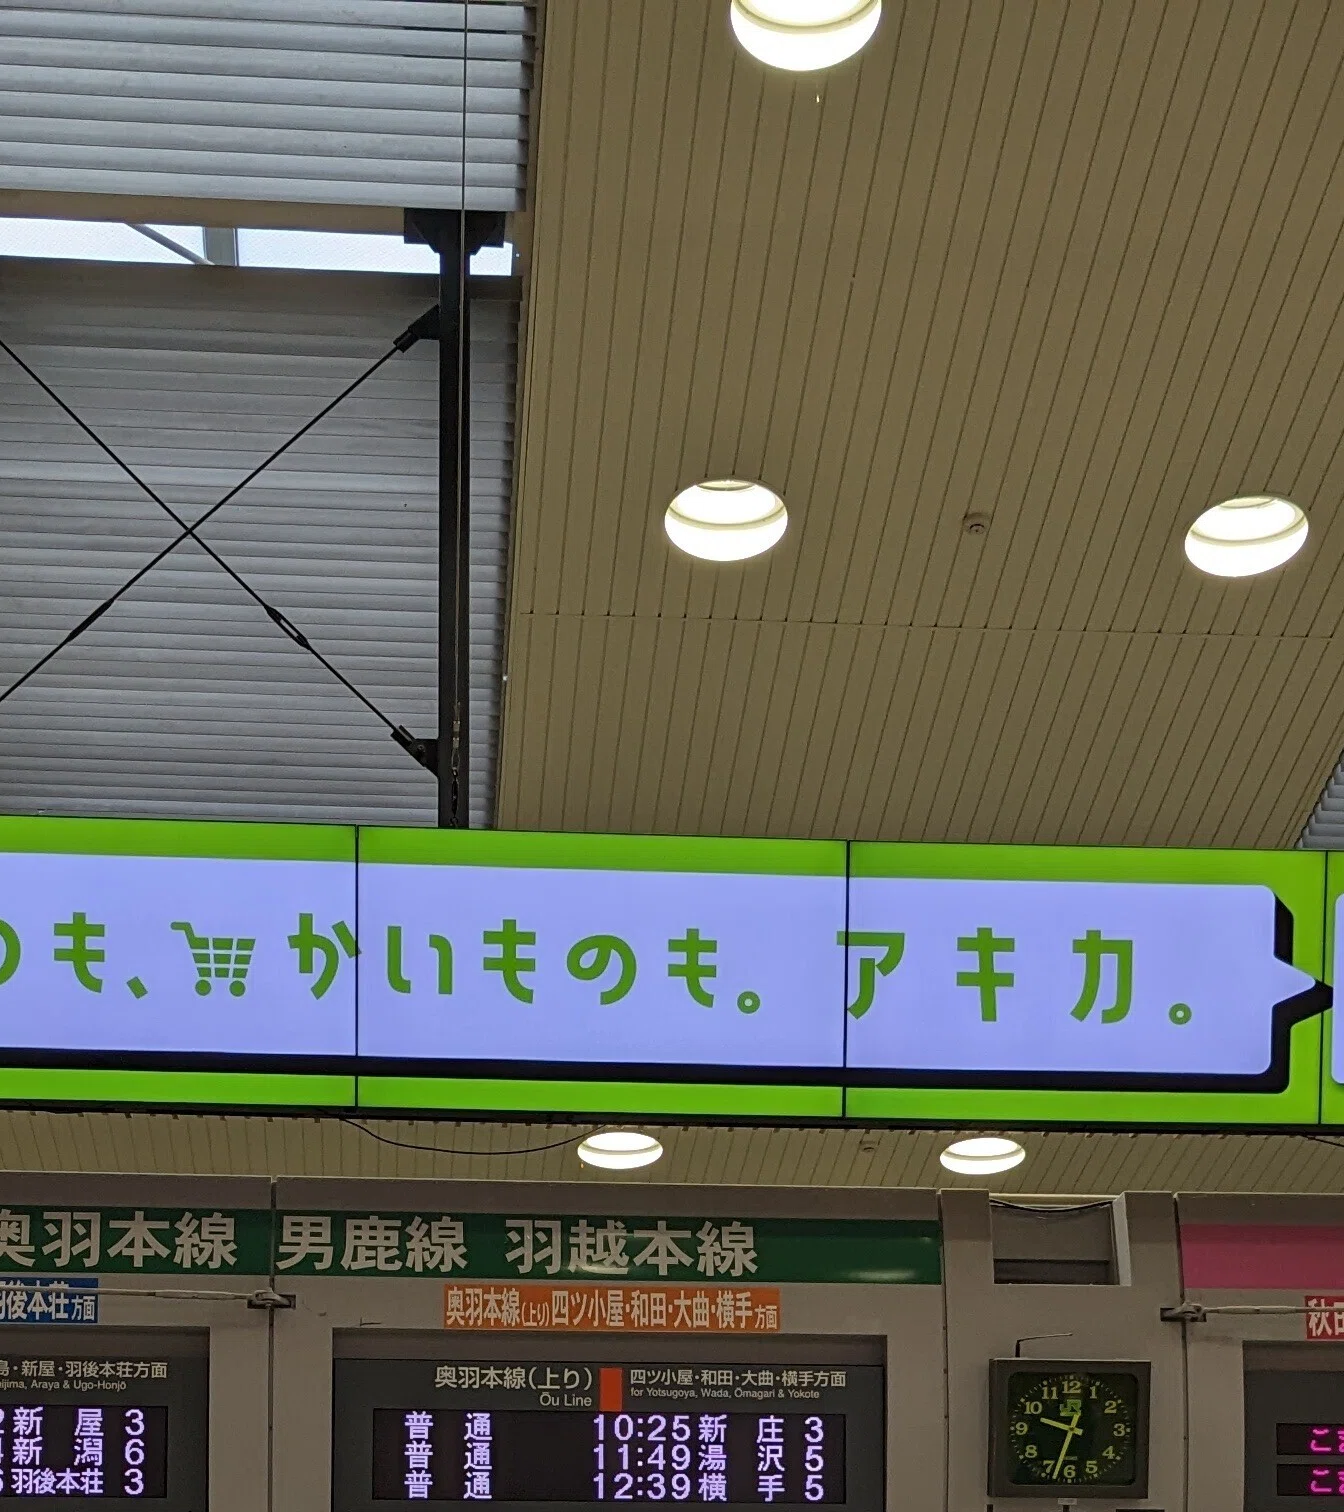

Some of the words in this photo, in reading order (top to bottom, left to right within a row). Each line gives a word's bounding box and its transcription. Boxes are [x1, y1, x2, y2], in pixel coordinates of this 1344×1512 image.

[278, 1213, 467, 1275] 男鹿線
[506, 1217, 758, 1278] 羽越本線
[31, 1379, 60, 1391] Araya
[564, 1393, 592, 1407] Line
[124, 1409, 144, 1436] 3
[594, 1413, 691, 1442] 10:25
[124, 1438, 144, 1465] 6
[594, 1442, 691, 1472] 11:49
[124, 1468, 144, 1495] 3
[594, 1472, 691, 1502] 12:39
